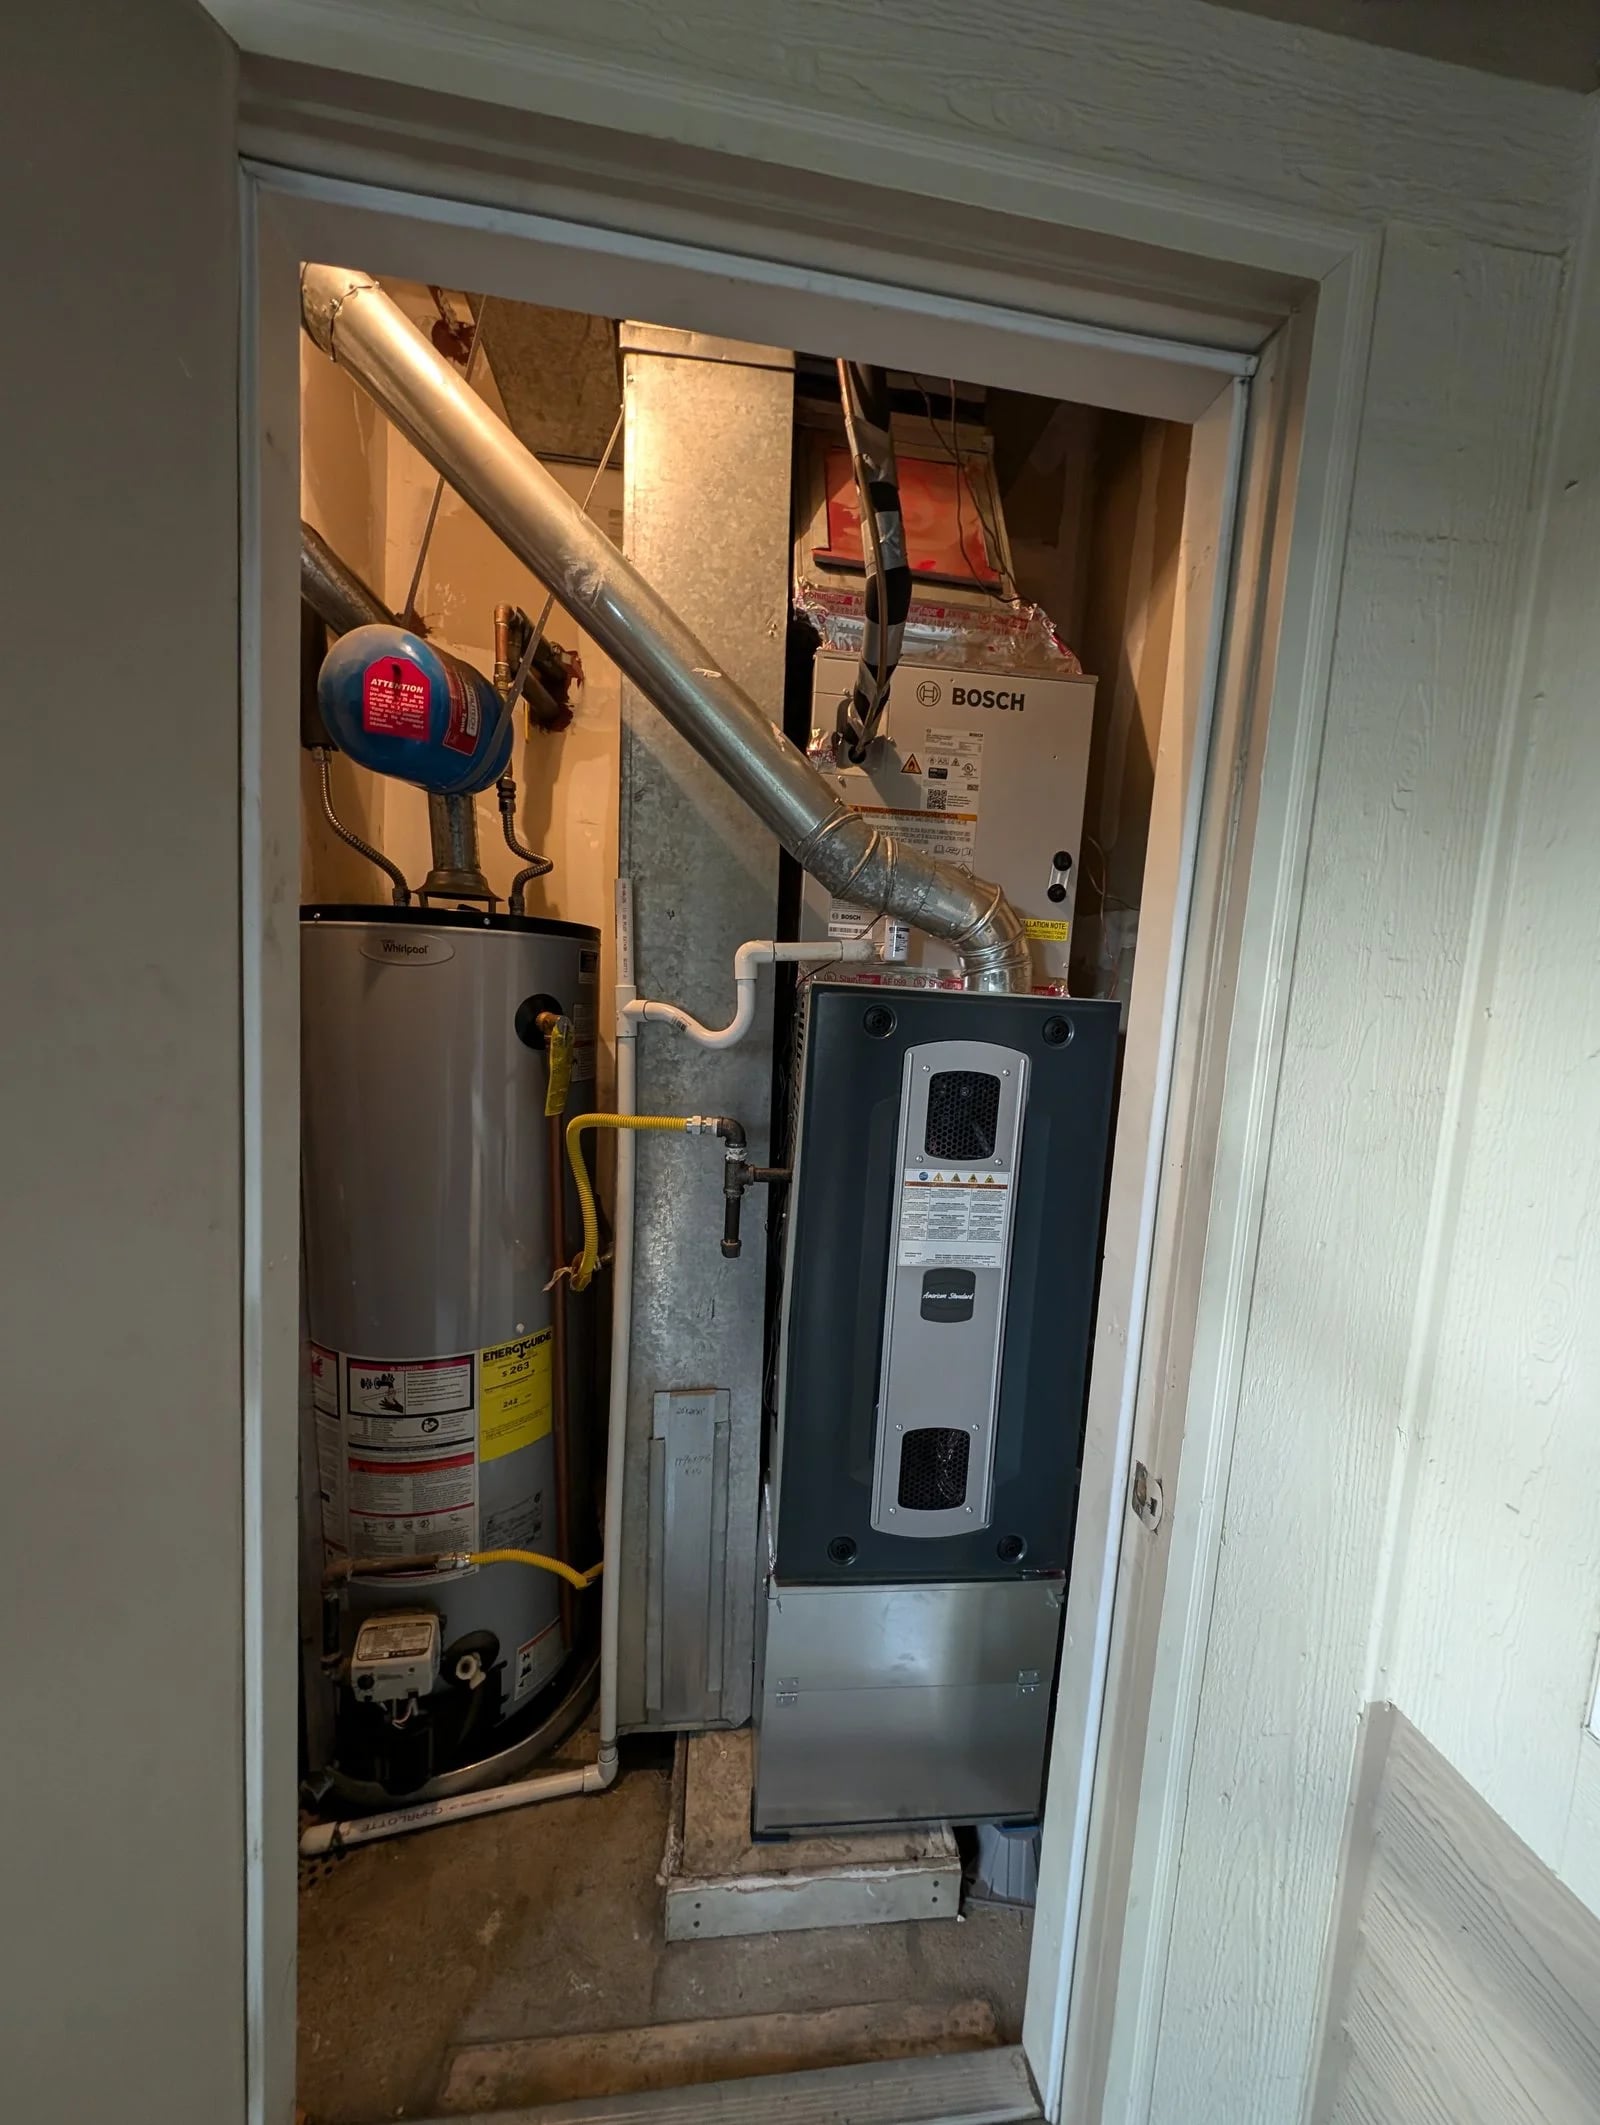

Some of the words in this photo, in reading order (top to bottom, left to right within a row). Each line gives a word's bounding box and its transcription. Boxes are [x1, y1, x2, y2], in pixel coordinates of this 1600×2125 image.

[370, 678, 424, 694] ATTENTION
[952, 687, 1025, 712] BOSCH
[382, 943, 427, 956] Whirlpool
[923, 1291, 947, 1299] American
[948, 1292, 974, 1300] Standard
[482, 1331, 553, 1362] ENERGYGUIDE
[509, 1361, 530, 1376] 263
